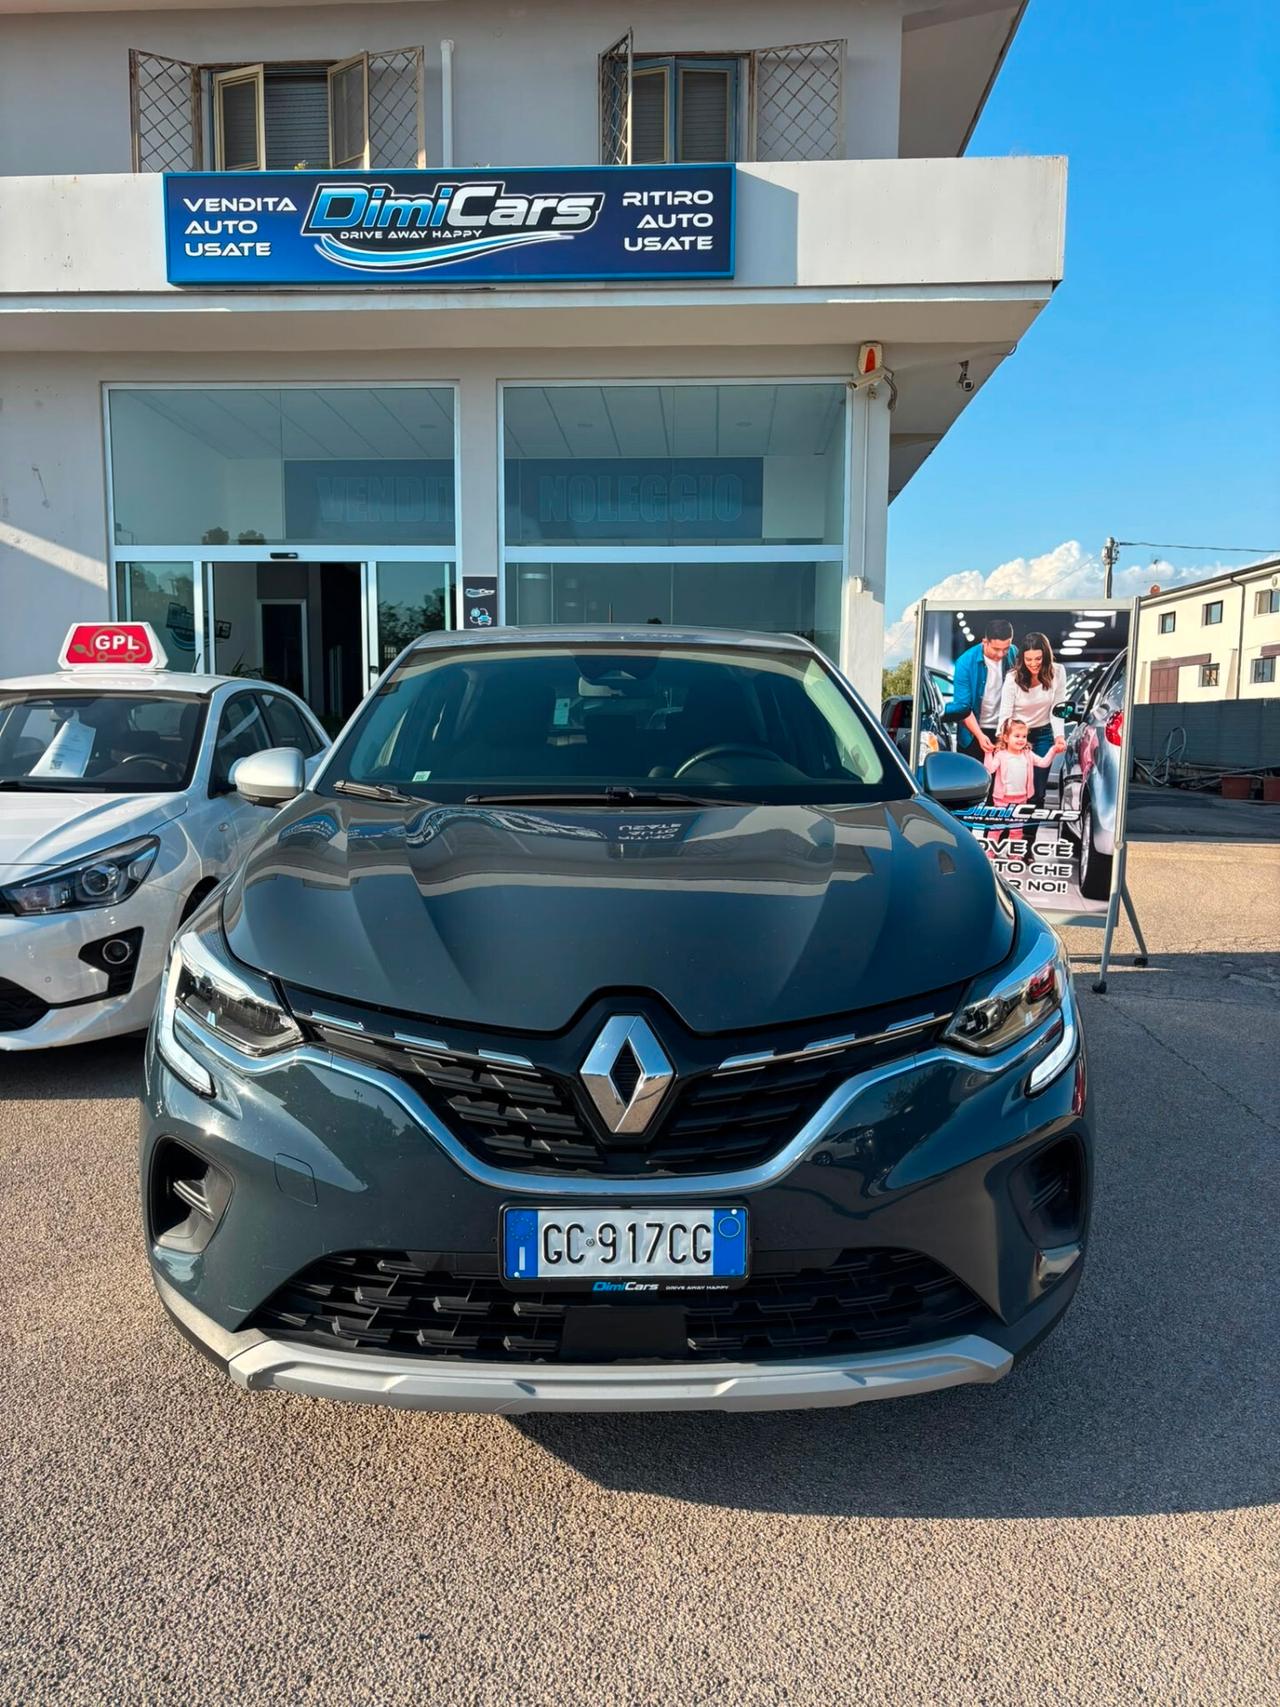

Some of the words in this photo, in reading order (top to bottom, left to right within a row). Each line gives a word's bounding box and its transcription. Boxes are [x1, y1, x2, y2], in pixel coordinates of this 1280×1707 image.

[183, 197, 297, 212] VENDITA
[622, 190, 714, 206] RITIRO
[308, 186, 597, 229] DimiCars
[184, 219, 258, 235] AUTO
[636, 213, 714, 229] AUTO
[340, 231, 383, 239] DRIVE
[388, 230, 428, 239] AWAY
[432, 229, 483, 238] HAPPY
[184, 242, 271, 257] USATE
[624, 235, 714, 251] USATE
[539, 474, 743, 522] NOLEGGIO
[95, 635, 140, 650] GPL
[1033, 839, 1071, 857] C'È
[1030, 864, 1071, 877] CHE
[1028, 881, 1066, 893] NOI!
[592, 1281, 659, 1291] DimiCars
